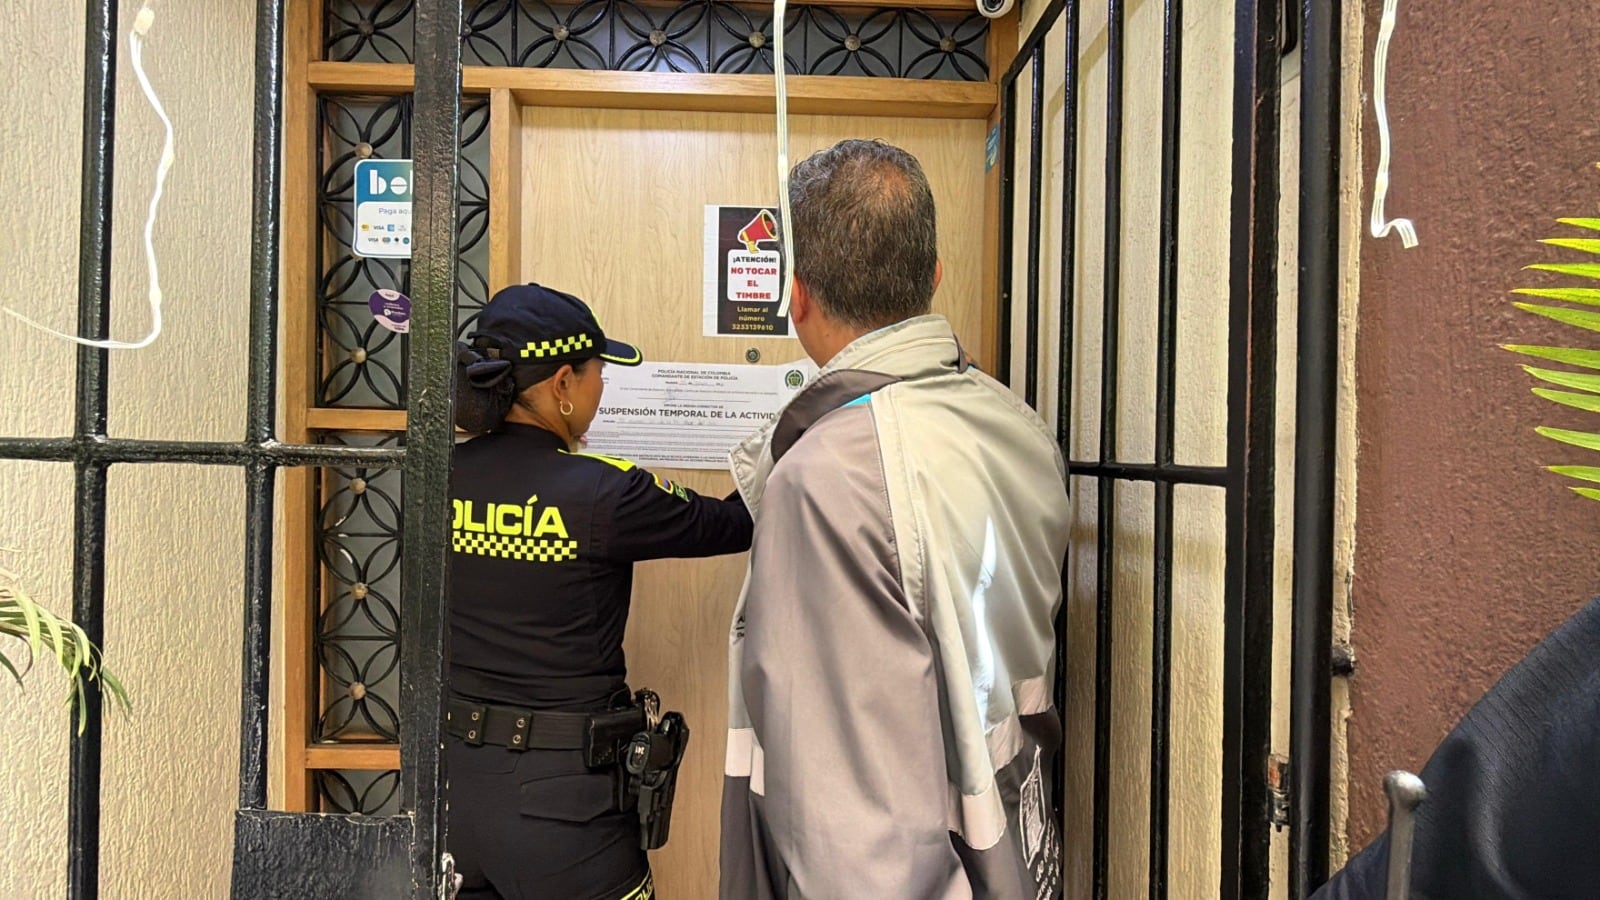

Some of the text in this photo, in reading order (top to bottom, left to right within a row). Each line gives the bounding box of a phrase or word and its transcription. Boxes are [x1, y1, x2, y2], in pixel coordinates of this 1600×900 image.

[379, 207, 397, 215] Paga
[733, 255, 777, 263] ¡ATENCIÓN!
[731, 267, 777, 276] NO TOCAR
[599, 406, 657, 417] SUSPENSIÓN
[659, 409, 708, 418] TEMPORAL
